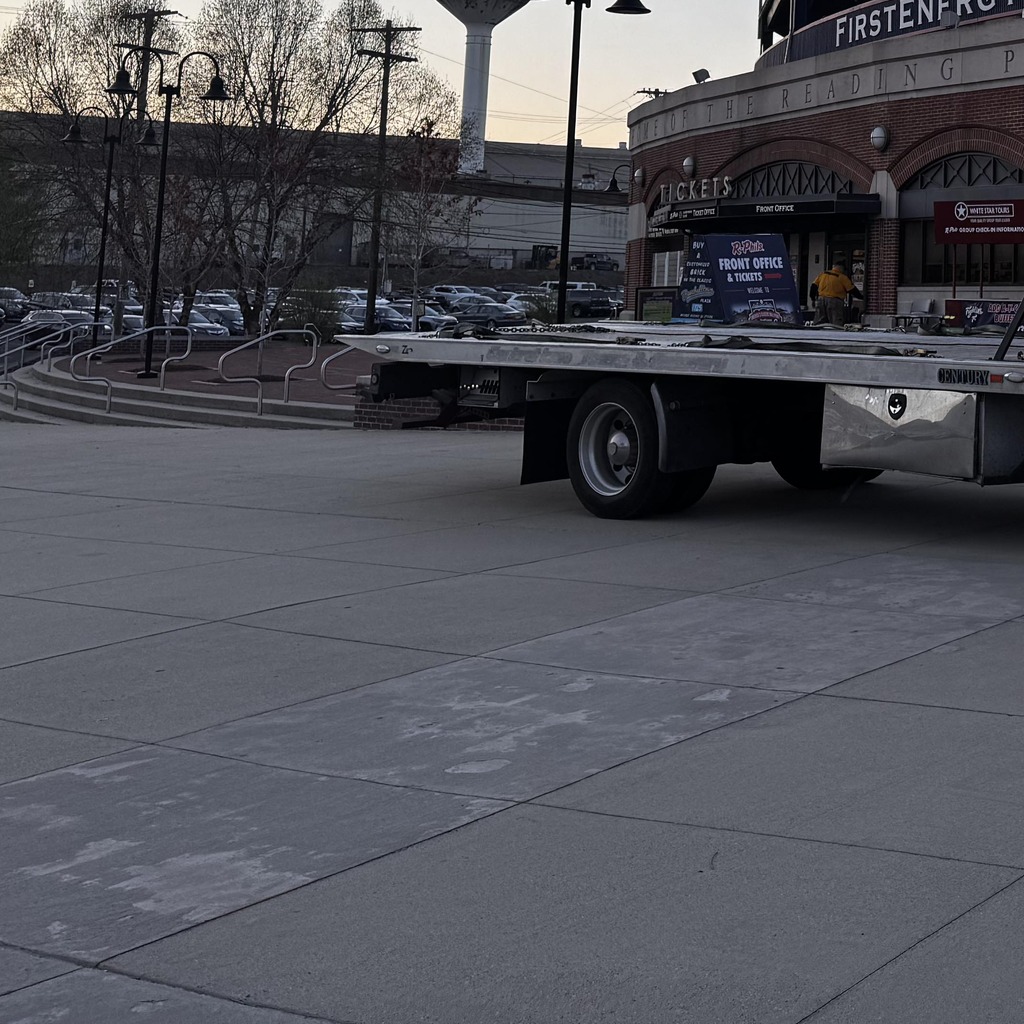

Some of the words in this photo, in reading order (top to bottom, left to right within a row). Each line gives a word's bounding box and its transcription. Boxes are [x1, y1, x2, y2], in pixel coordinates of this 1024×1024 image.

[671, 109, 688, 131] OF
[707, 95, 753, 123] THE
[782, 58, 954, 109] READING
[660, 176, 730, 204] TICKETS
[756, 205, 774, 213] FRONT
[775, 204, 794, 212] OFFICE
[969, 207, 984, 215] WHITE
[995, 206, 1010, 214] TOURS
[692, 241, 705, 249] BUY
[719, 257, 751, 270] FRONT
[752, 256, 783, 269] OFFICE
[727, 273, 733, 282] &
[734, 272, 763, 282] TICKETS
[994, 313, 1015, 323] BUFFE
[937, 367, 990, 385] CENTURY
